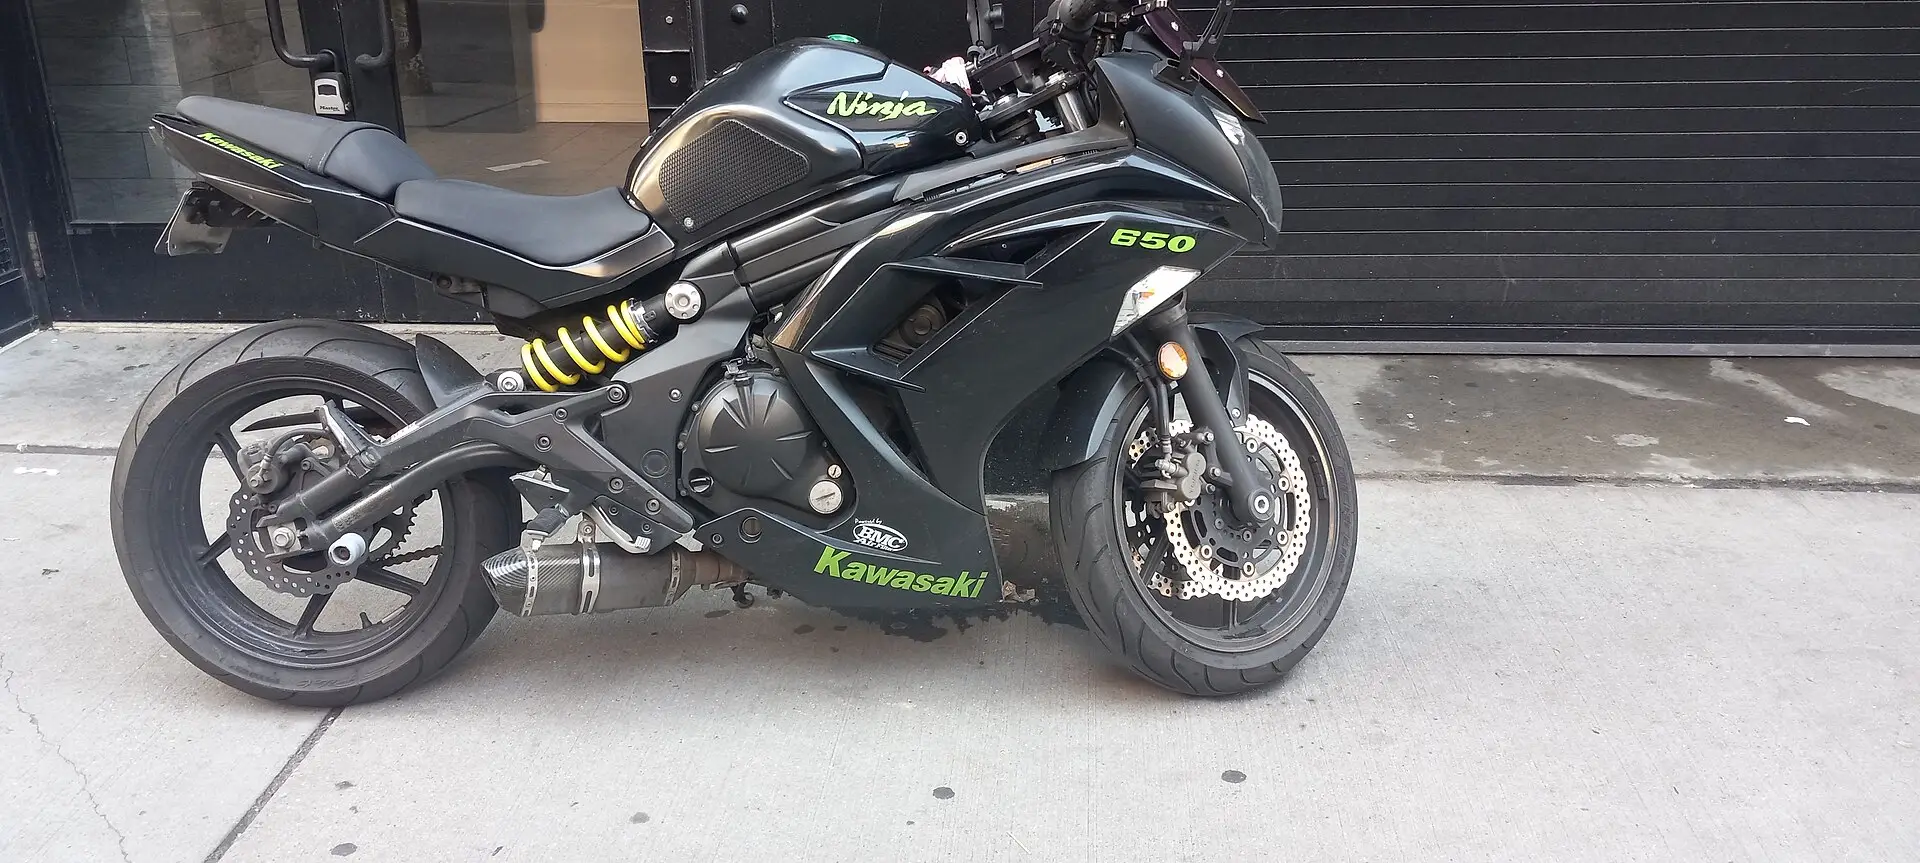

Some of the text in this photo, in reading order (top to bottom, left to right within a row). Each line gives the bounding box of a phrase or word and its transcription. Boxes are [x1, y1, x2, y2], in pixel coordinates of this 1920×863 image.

[826, 90, 938, 122] Ninja
[196, 132, 285, 170] Kawasaki
[1109, 228, 1197, 254] 650
[857, 525, 905, 549] BMC
[813, 545, 989, 599] Kawasaki
